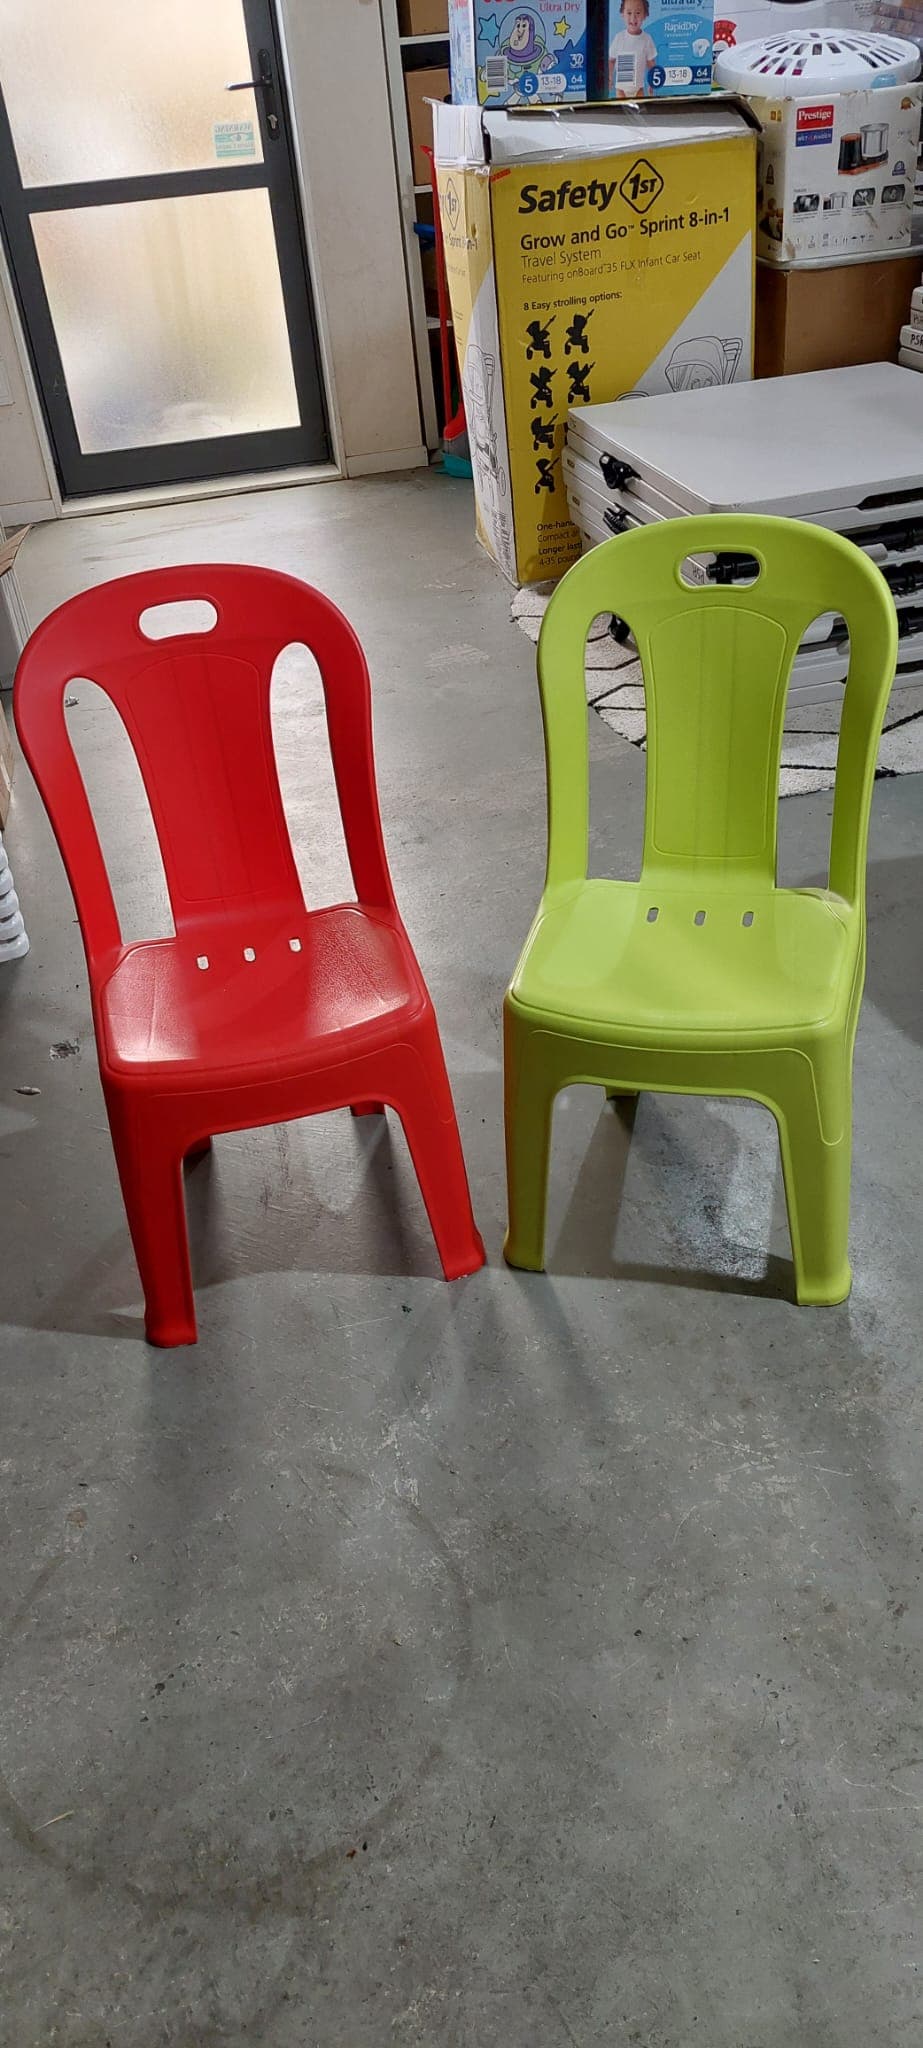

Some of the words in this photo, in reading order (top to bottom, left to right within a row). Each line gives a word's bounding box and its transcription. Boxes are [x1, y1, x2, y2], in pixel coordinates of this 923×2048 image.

[539, 3, 562, 13] Ultra
[564, 2, 580, 12] Dry
[570, 74, 583, 84] 64
[652, 71, 661, 86] 5
[696, 67, 708, 77] 64
[524, 78, 533, 93] 5
[541, 75, 563, 86] 13-18
[798, 109, 832, 121] Prestige
[518, 179, 617, 214] Safety
[629, 173, 657, 200] 1ST
[521, 234, 566, 250] Grow
[571, 224, 600, 244] and
[640, 214, 685, 238] Sprint
[689, 207, 729, 227] 8-in-1
[521, 251, 556, 268] Travel
[560, 249, 601, 267] System
[522, 271, 564, 283] Featuring
[620, 261, 635, 271] FLX
[638, 256, 663, 268] Infant
[665, 254, 680, 265] Car
[683, 250, 701, 262] Seat
[523, 302, 529, 310] 8
[531, 301, 551, 311] Easy
[553, 295, 587, 307] strolling
[589, 291, 623, 304] options:
[539, 546, 565, 555] Longer
